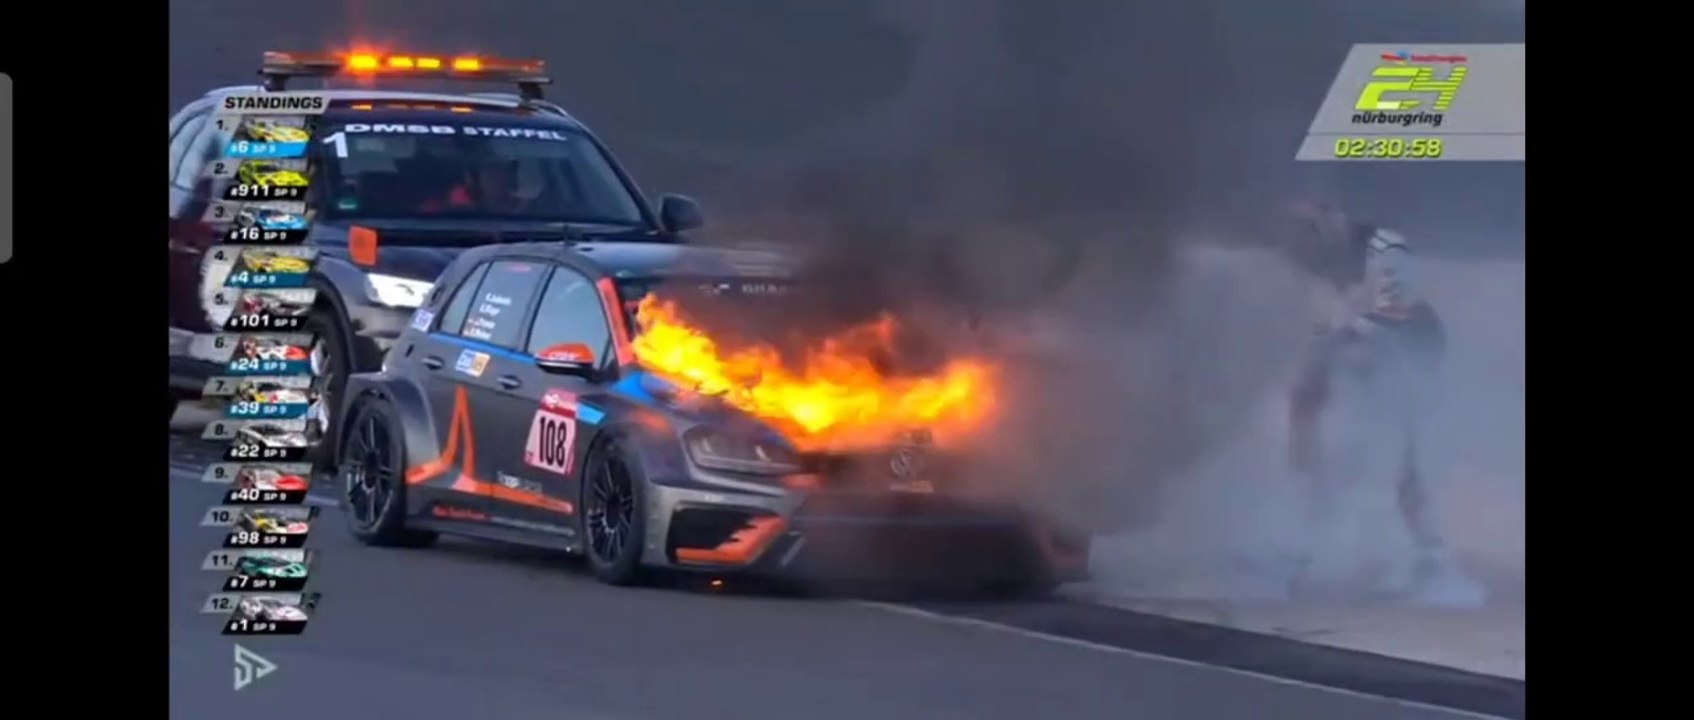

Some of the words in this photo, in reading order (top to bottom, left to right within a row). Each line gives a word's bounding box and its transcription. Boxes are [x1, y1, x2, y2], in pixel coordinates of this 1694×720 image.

[323, 131, 349, 158] 1
[345, 123, 456, 134] DMSB
[462, 126, 566, 141] STAFFEL
[538, 416, 568, 468] 108
